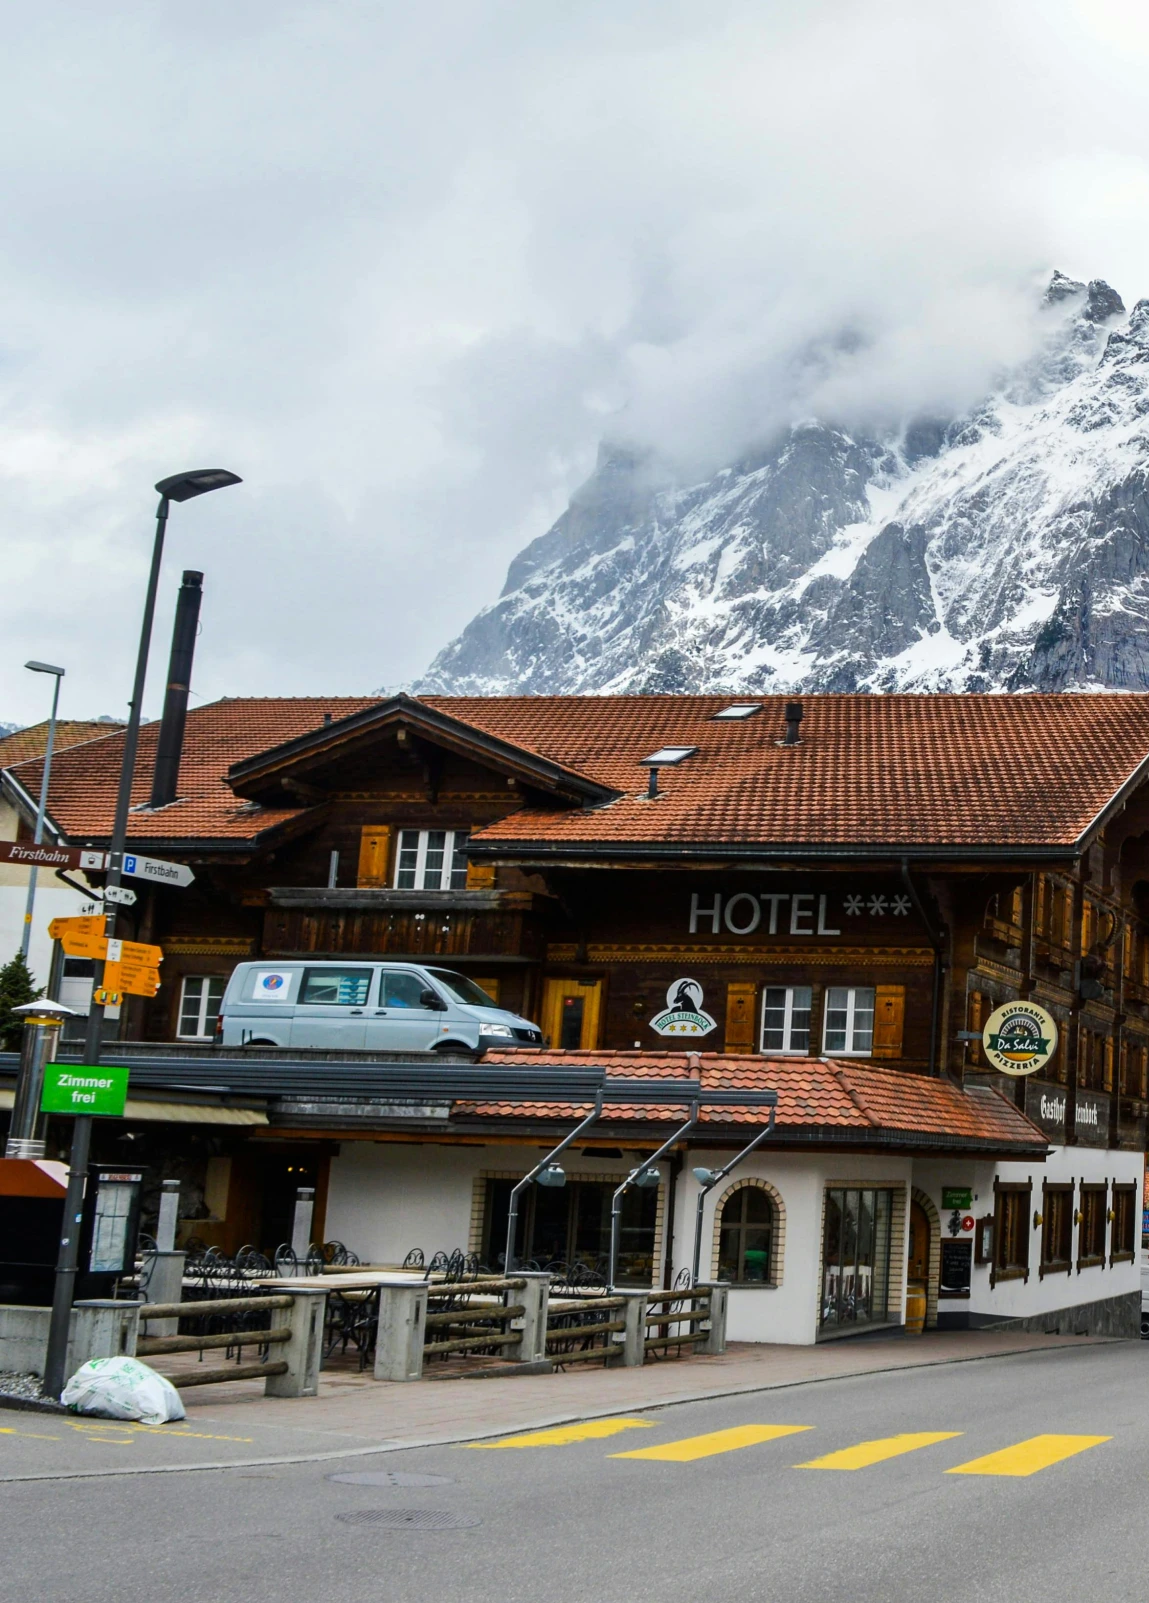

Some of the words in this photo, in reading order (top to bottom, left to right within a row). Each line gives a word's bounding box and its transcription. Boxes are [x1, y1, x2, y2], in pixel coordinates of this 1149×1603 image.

[8, 846, 70, 863] Firstbahn
[126, 858, 135, 871] P
[144, 862, 179, 879] Firstbahn
[688, 892, 842, 936] HOTEL
[657, 1014, 676, 1029] HOTEL
[677, 1012, 709, 1030] STEINBOCK
[1001, 1006, 1046, 1025] RISTORANTE
[997, 1038, 1011, 1050] Da
[1013, 1038, 1039, 1051] Salvi
[993, 1052, 1040, 1070] PIZZERIA
[57, 1074, 114, 1089] Zimmer
[71, 1091, 97, 1104] frei
[1040, 1093, 1067, 1126] Gasthof
[1075, 1101, 1098, 1126] teinbock
